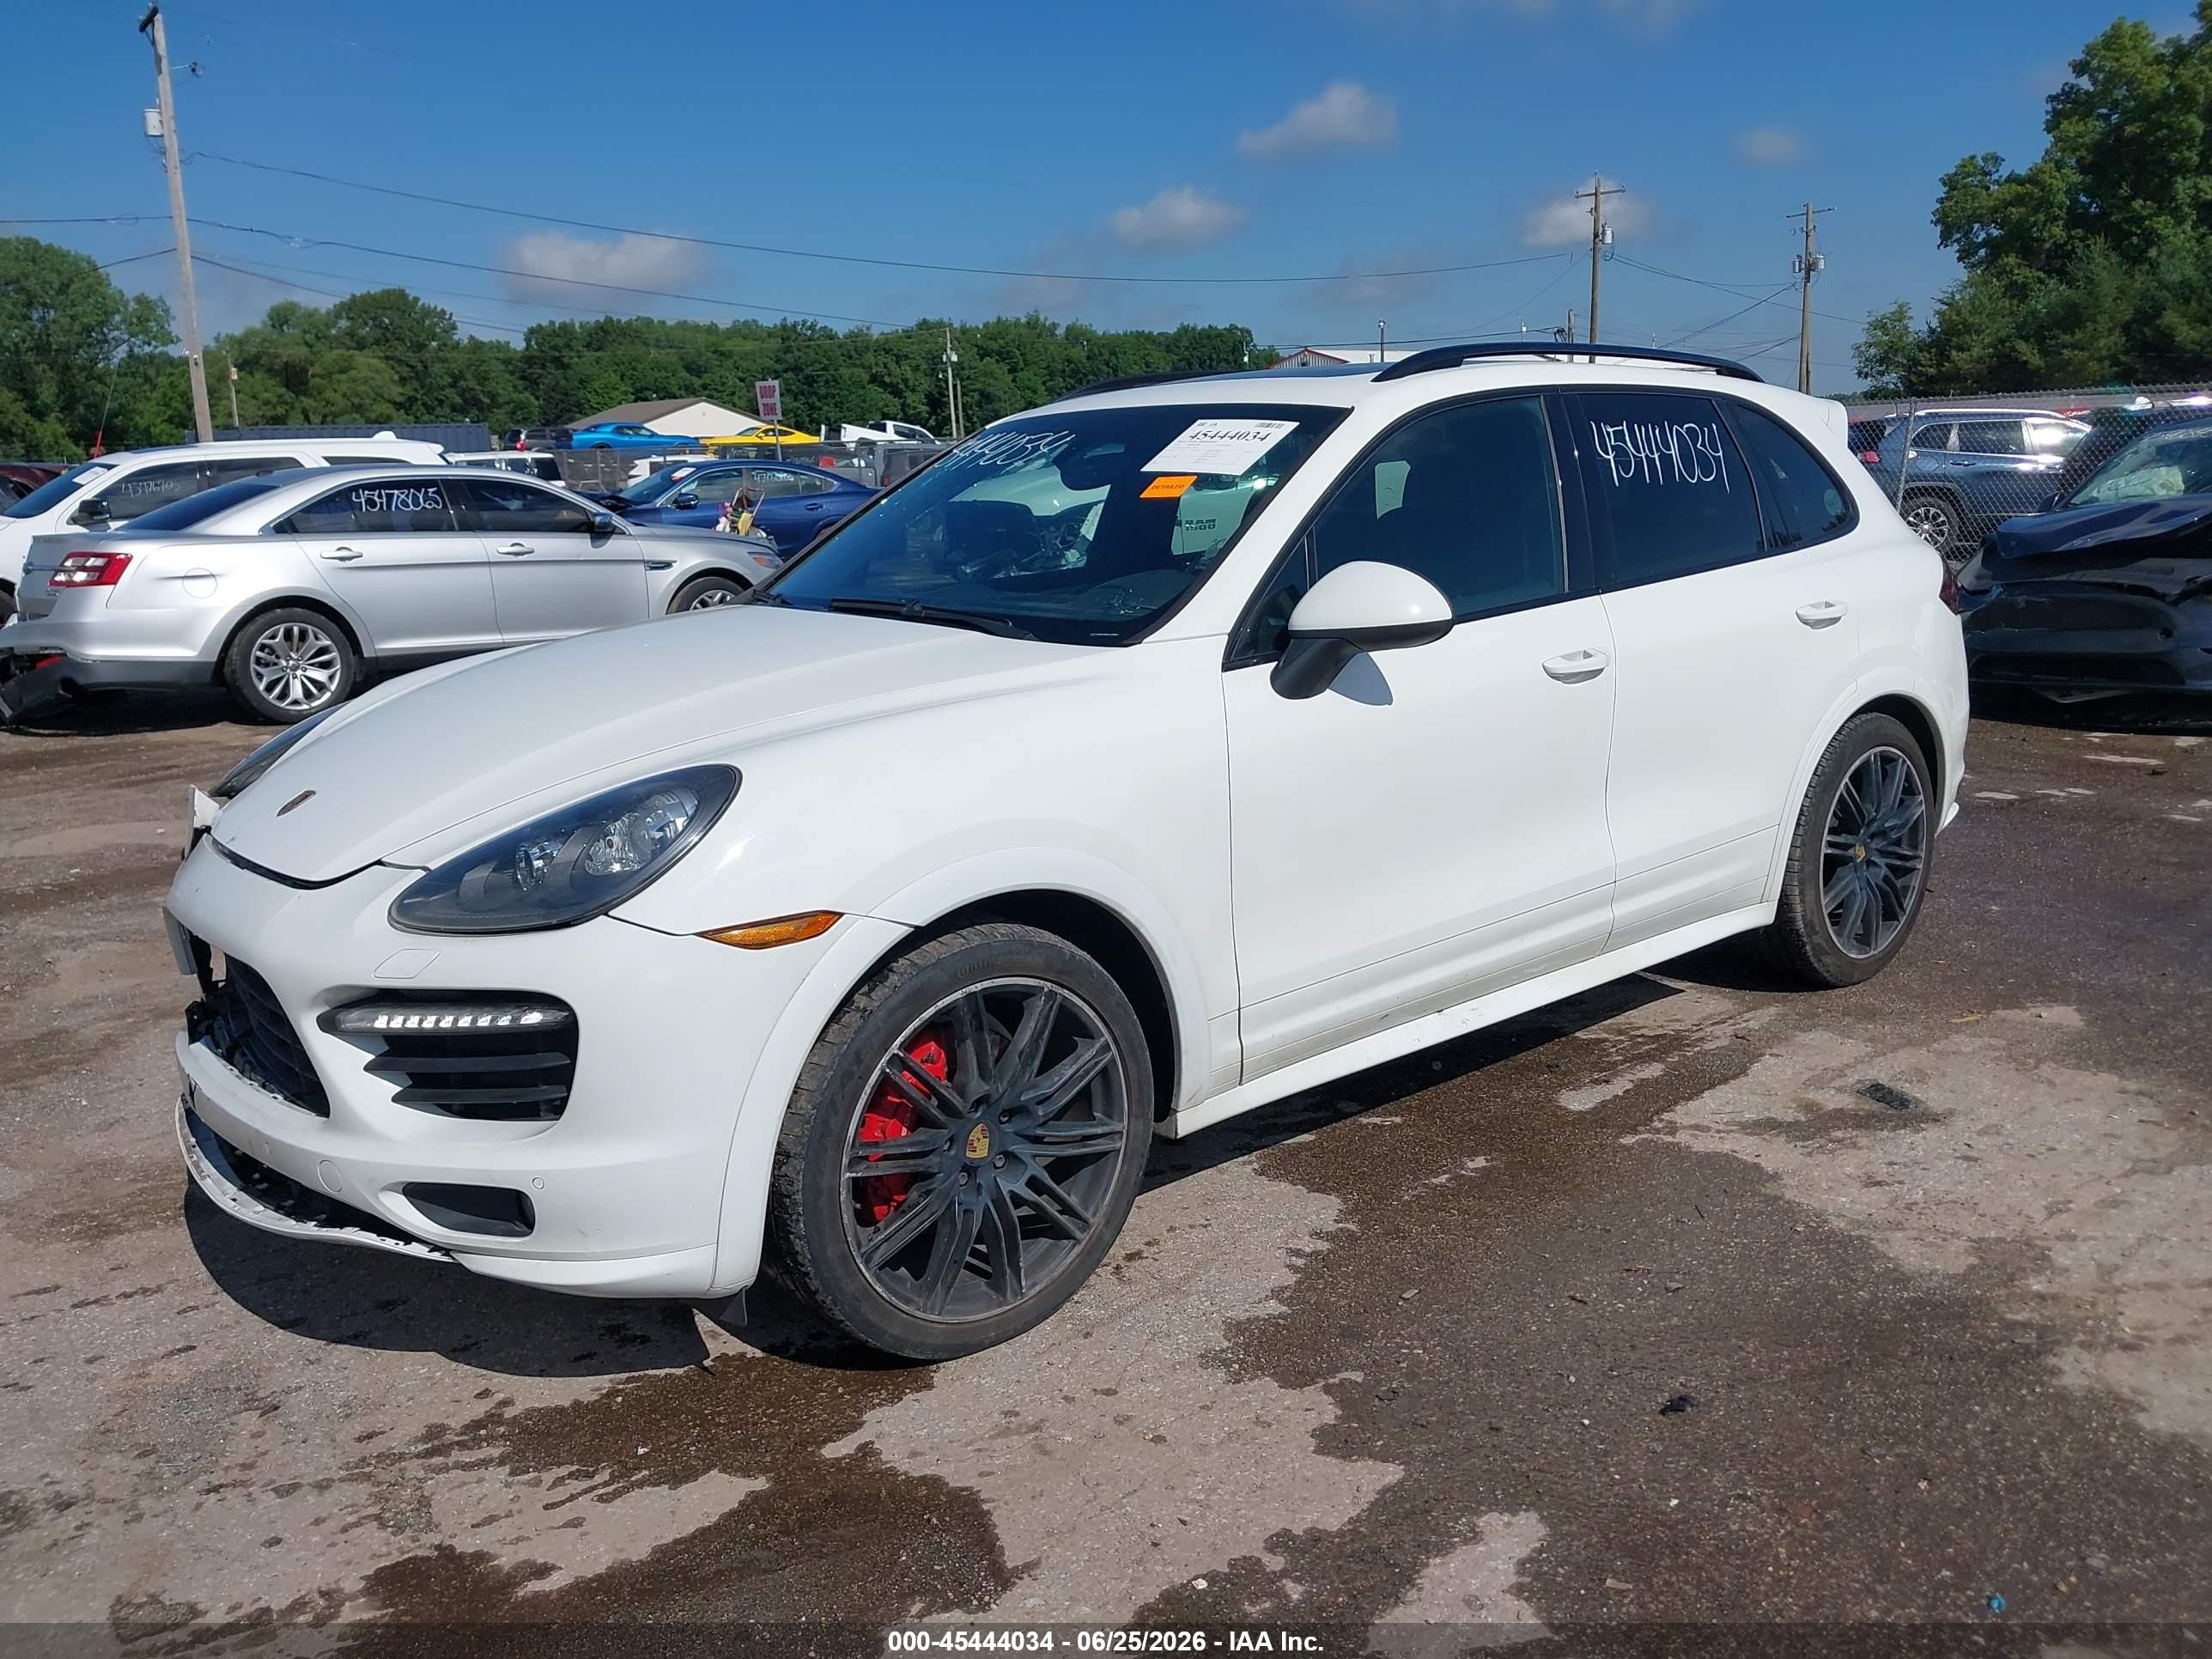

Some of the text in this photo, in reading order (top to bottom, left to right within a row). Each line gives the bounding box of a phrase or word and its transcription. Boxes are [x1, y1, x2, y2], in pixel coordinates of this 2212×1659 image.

[759, 385, 776, 399] DROP
[762, 403, 778, 416] ZONE
[1188, 430, 1272, 442] 45444034
[1589, 420, 1730, 495] 45444034
[352, 488, 442, 513] 45478065
